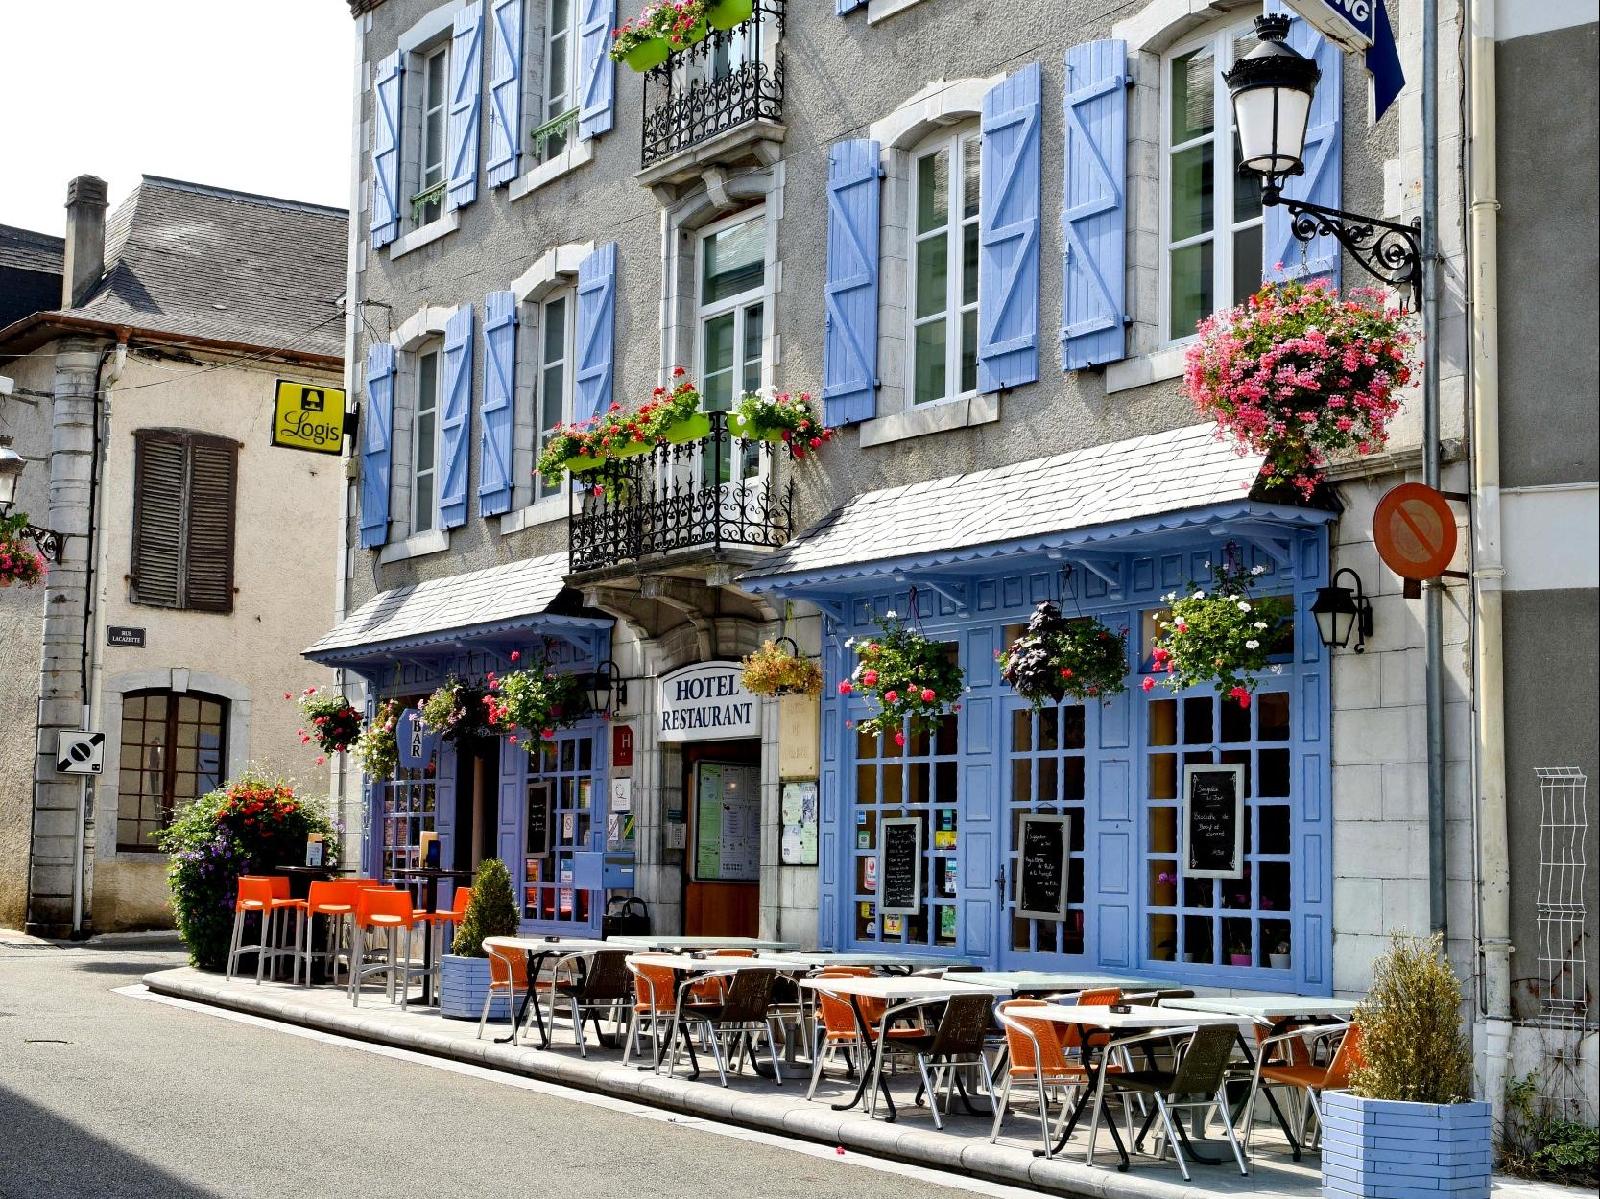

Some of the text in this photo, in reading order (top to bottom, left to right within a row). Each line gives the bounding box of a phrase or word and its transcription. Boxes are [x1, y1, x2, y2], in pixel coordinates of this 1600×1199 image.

[280, 410, 339, 445] Logis
[676, 674, 740, 701] HOTEL
[661, 702, 753, 731] RESTAURANT
[621, 733, 632, 749] H
